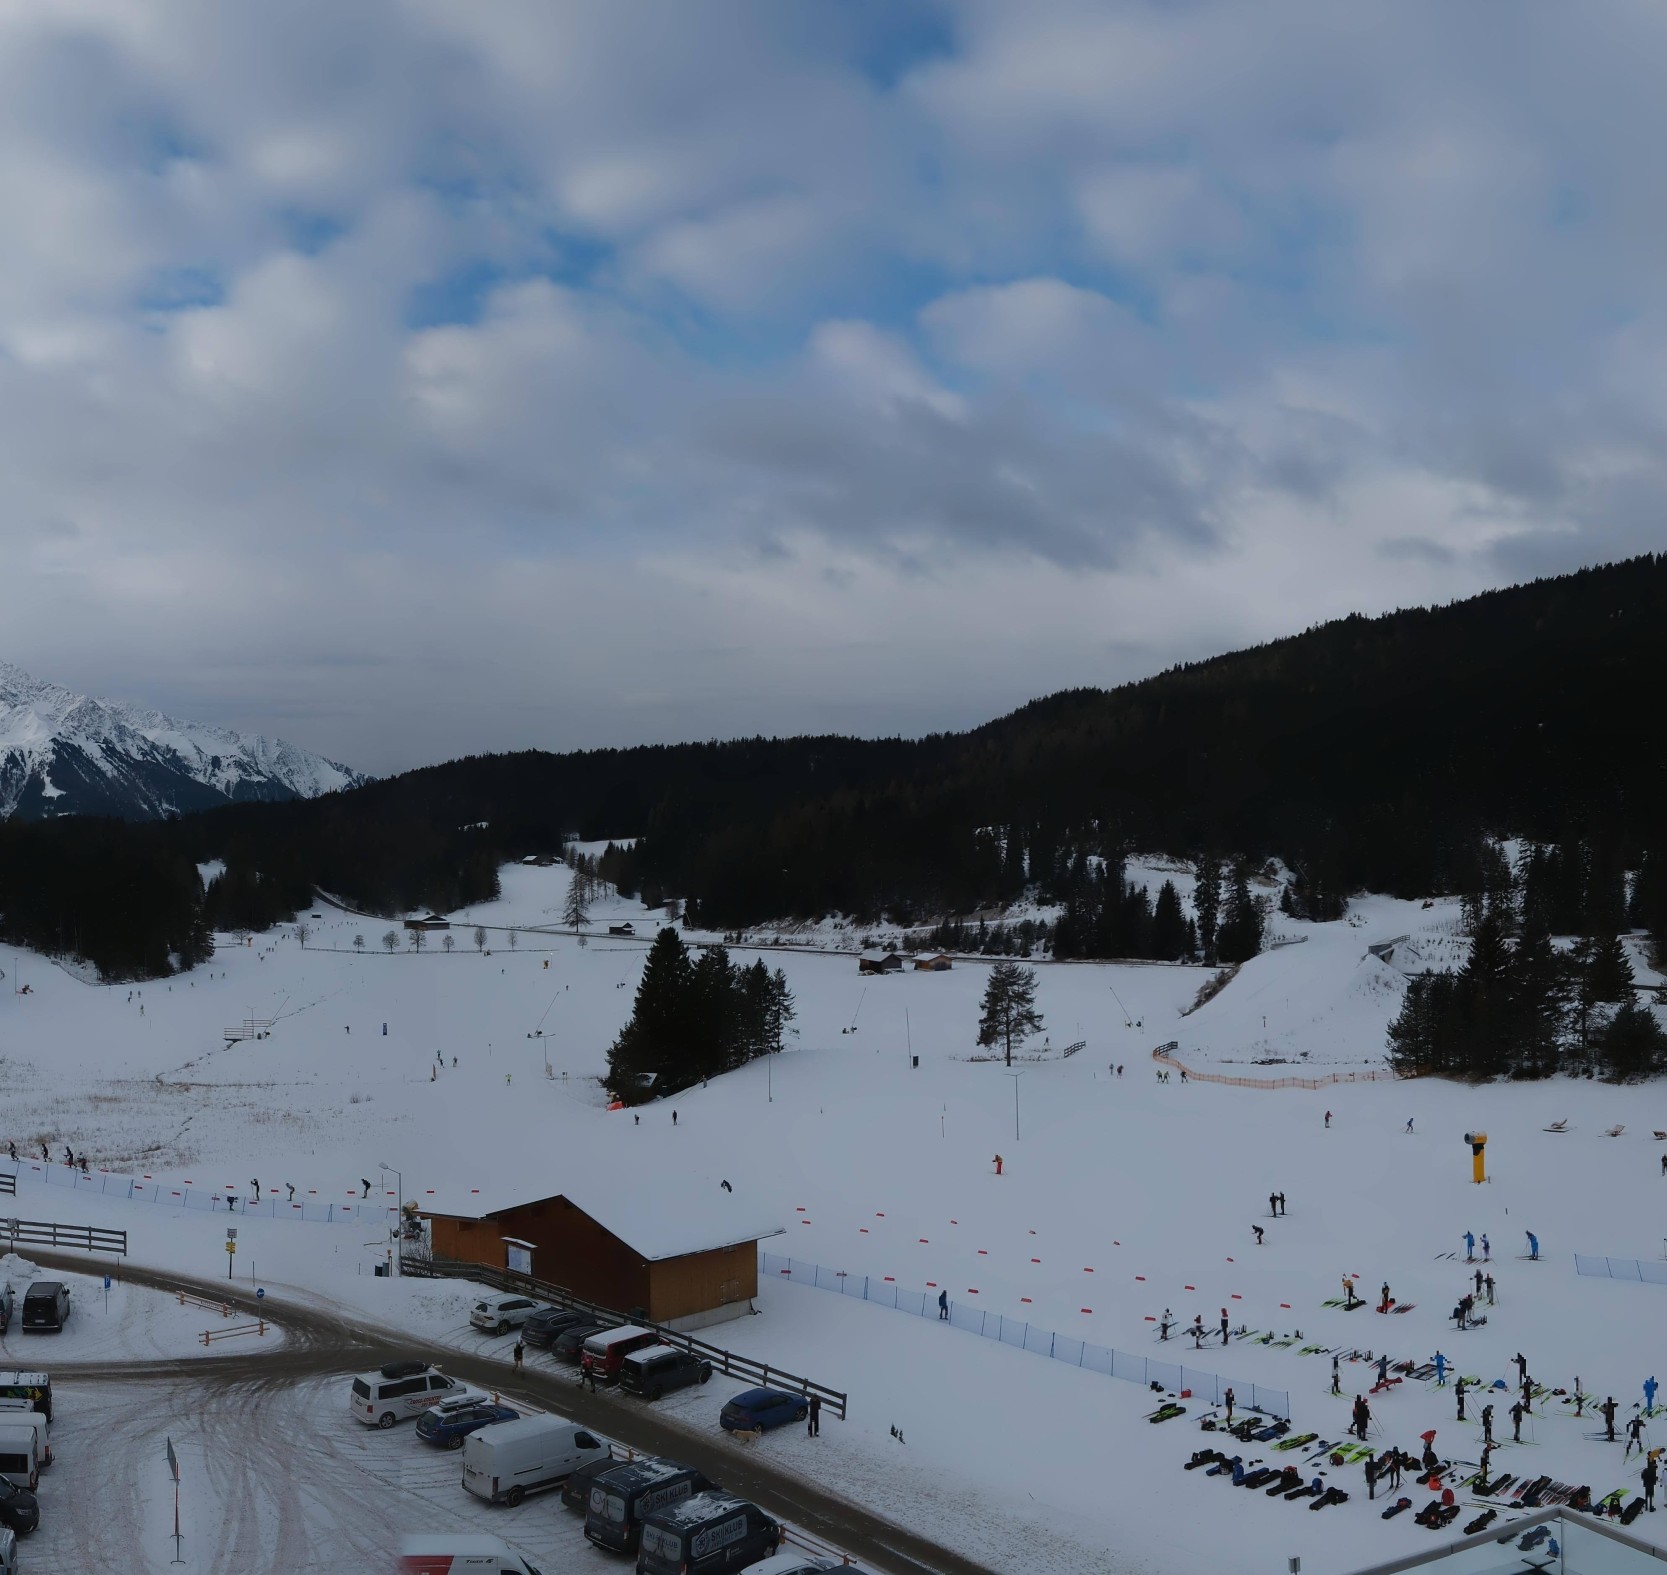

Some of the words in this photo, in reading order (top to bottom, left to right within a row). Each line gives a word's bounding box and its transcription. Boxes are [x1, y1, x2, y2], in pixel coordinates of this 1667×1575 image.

[656, 1490, 668, 1504] SKI
[669, 1483, 688, 1499] KLUB
[711, 1529, 723, 1542] SKI
[724, 1519, 743, 1536] KLUB
